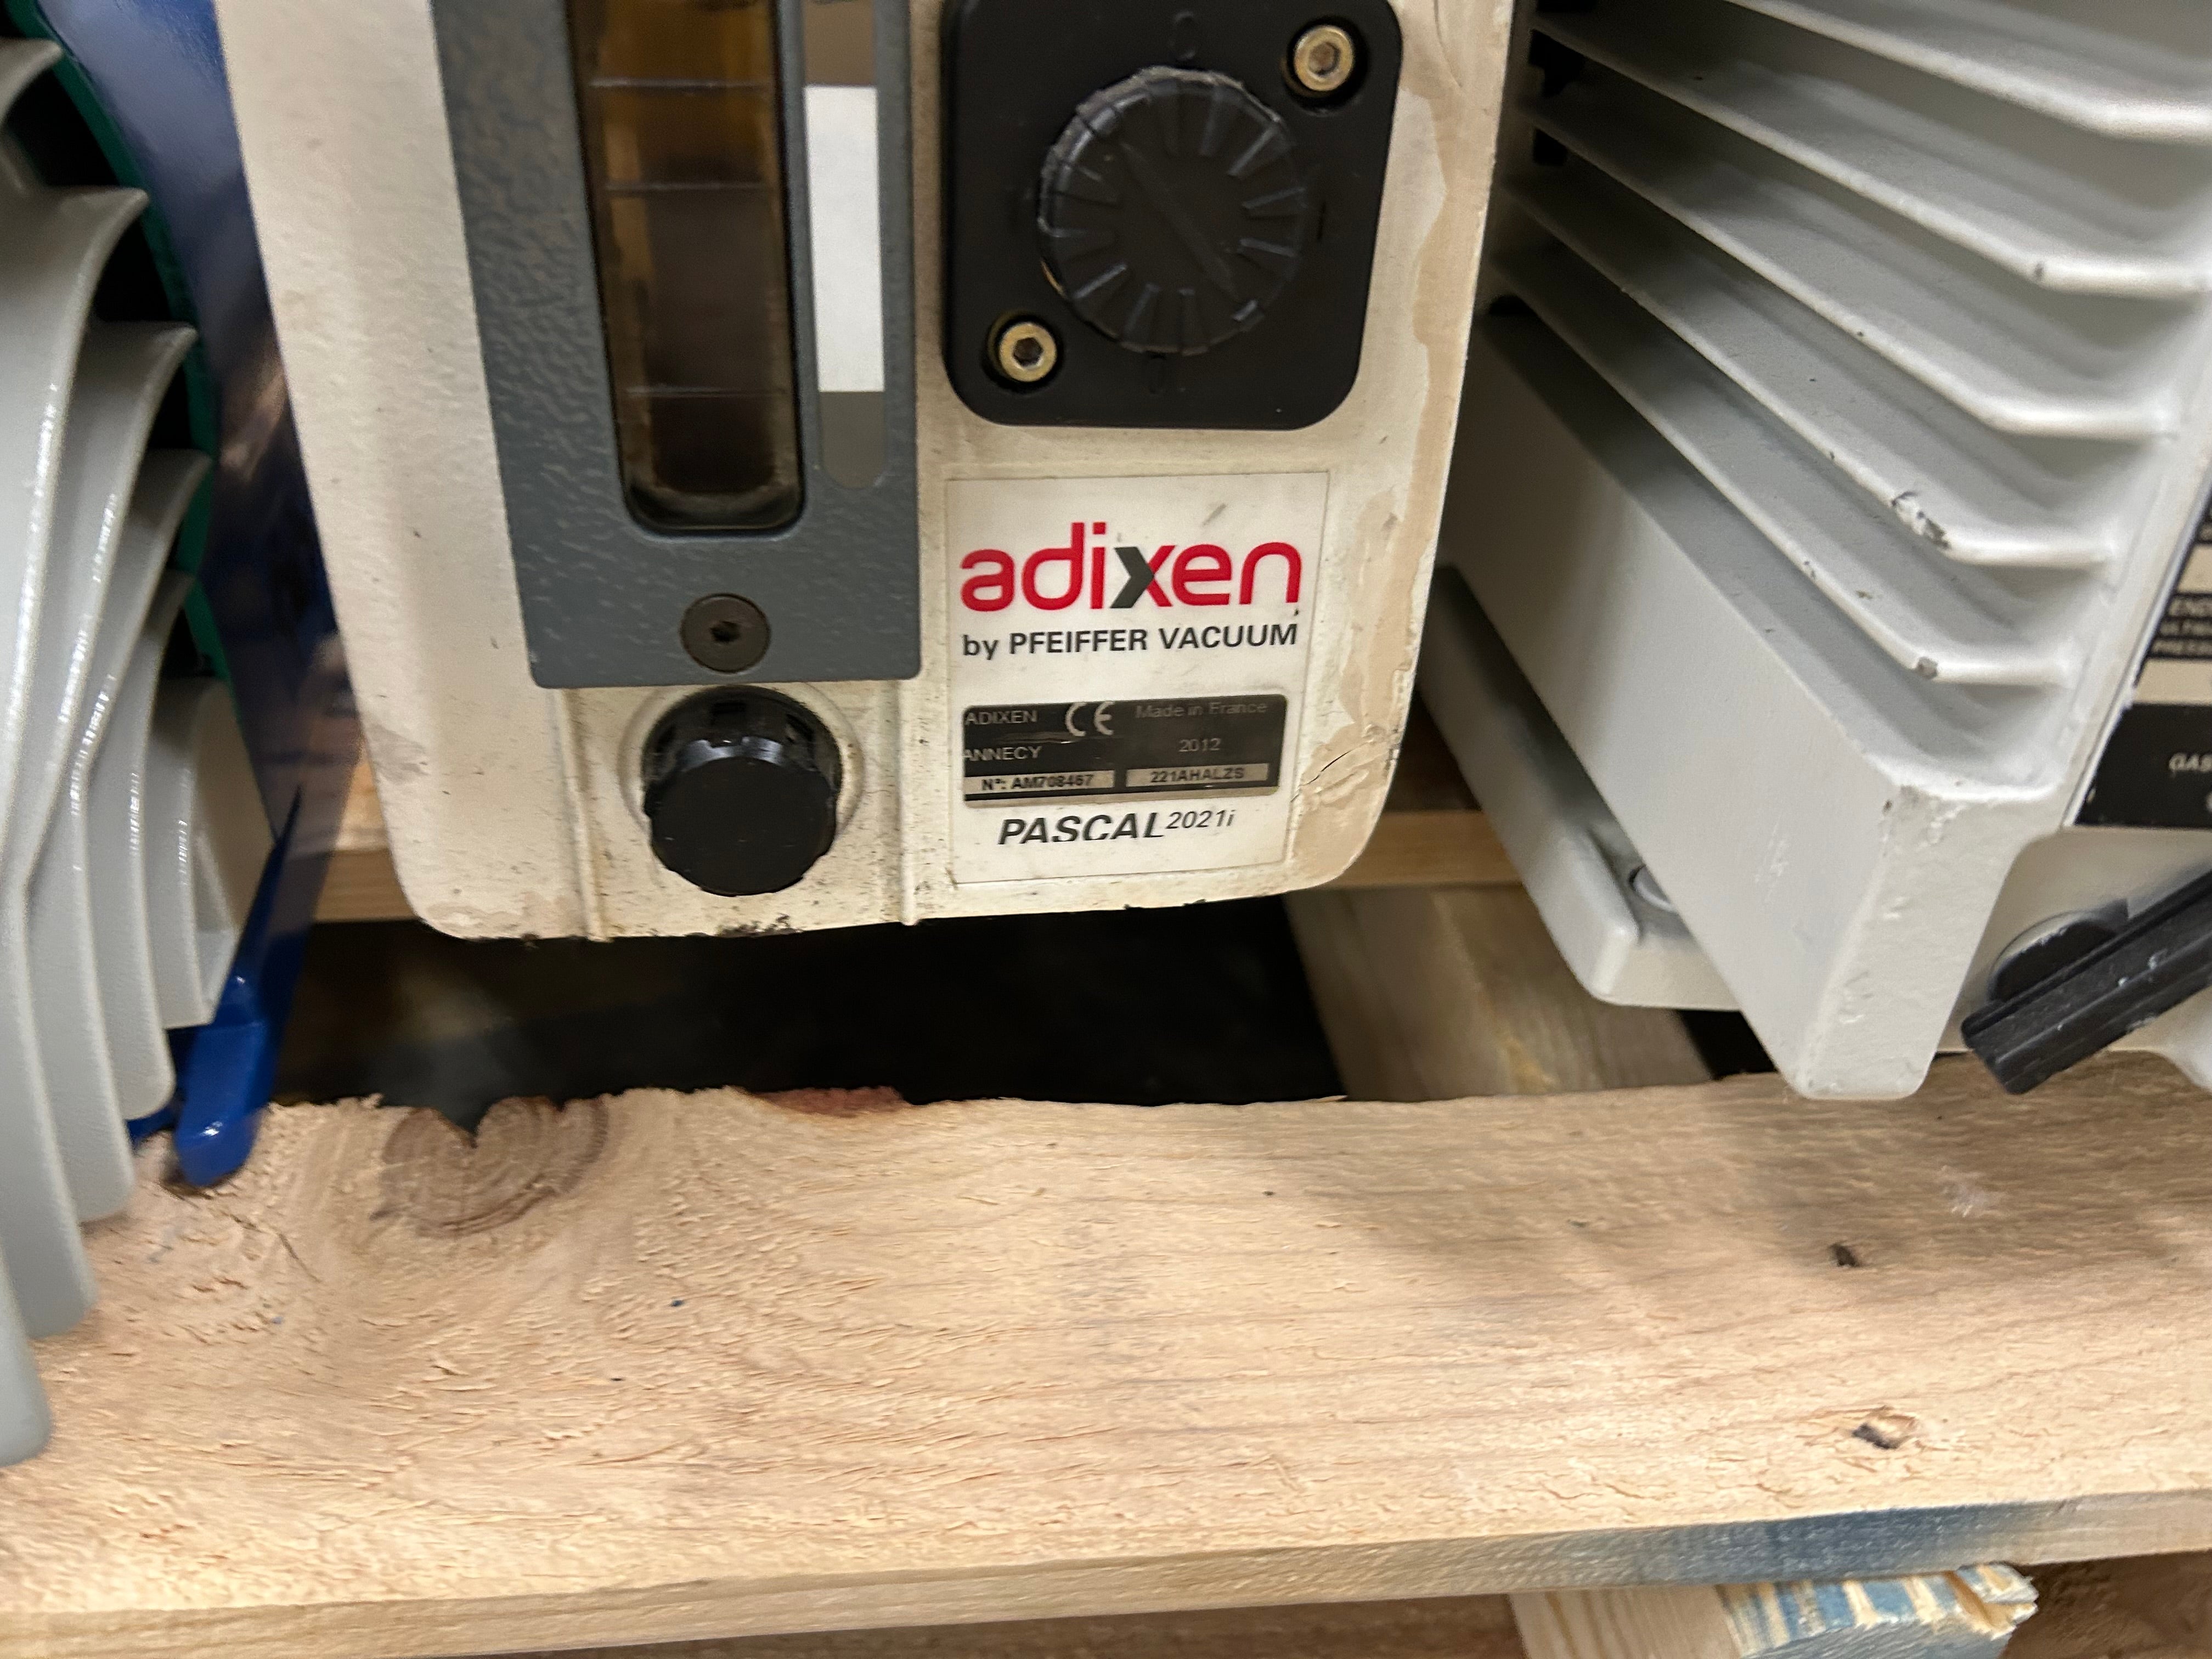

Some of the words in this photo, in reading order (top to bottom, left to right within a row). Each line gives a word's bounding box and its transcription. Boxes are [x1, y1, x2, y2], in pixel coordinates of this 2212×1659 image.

[960, 521, 1302, 612] adixen
[962, 635, 998, 660] by
[1009, 629, 1148, 654] PFEIFFER
[1159, 623, 1297, 650] VACUUM
[964, 709, 1038, 725] ADIXEN
[1135, 705, 1184, 718] Made
[1187, 704, 1204, 716] in
[1209, 701, 1267, 714] France
[962, 746, 1042, 761] ANNECY
[1178, 738, 1221, 753] 2012
[997, 812, 1165, 845] PASCAL
[1165, 809, 1236, 830] 2021i
